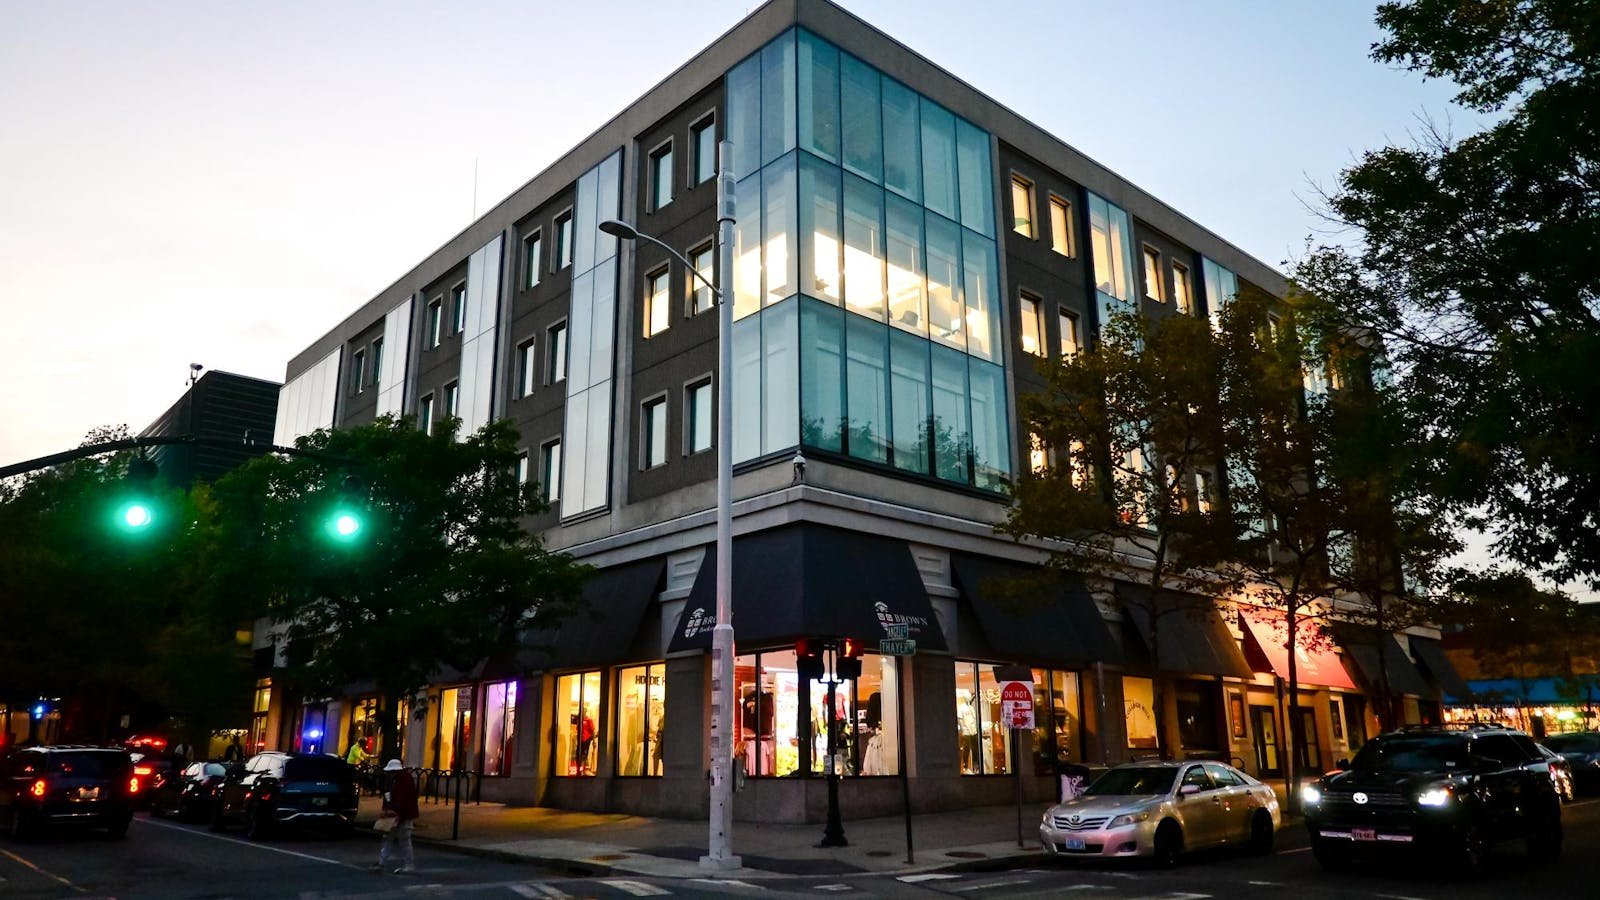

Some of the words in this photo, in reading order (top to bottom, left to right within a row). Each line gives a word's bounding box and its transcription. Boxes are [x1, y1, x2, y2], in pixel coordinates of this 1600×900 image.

[894, 614, 928, 625] BROWN
[635, 674, 660, 686] HODIE
[1004, 690, 1013, 699] DO
[1014, 690, 1028, 699] NOT
